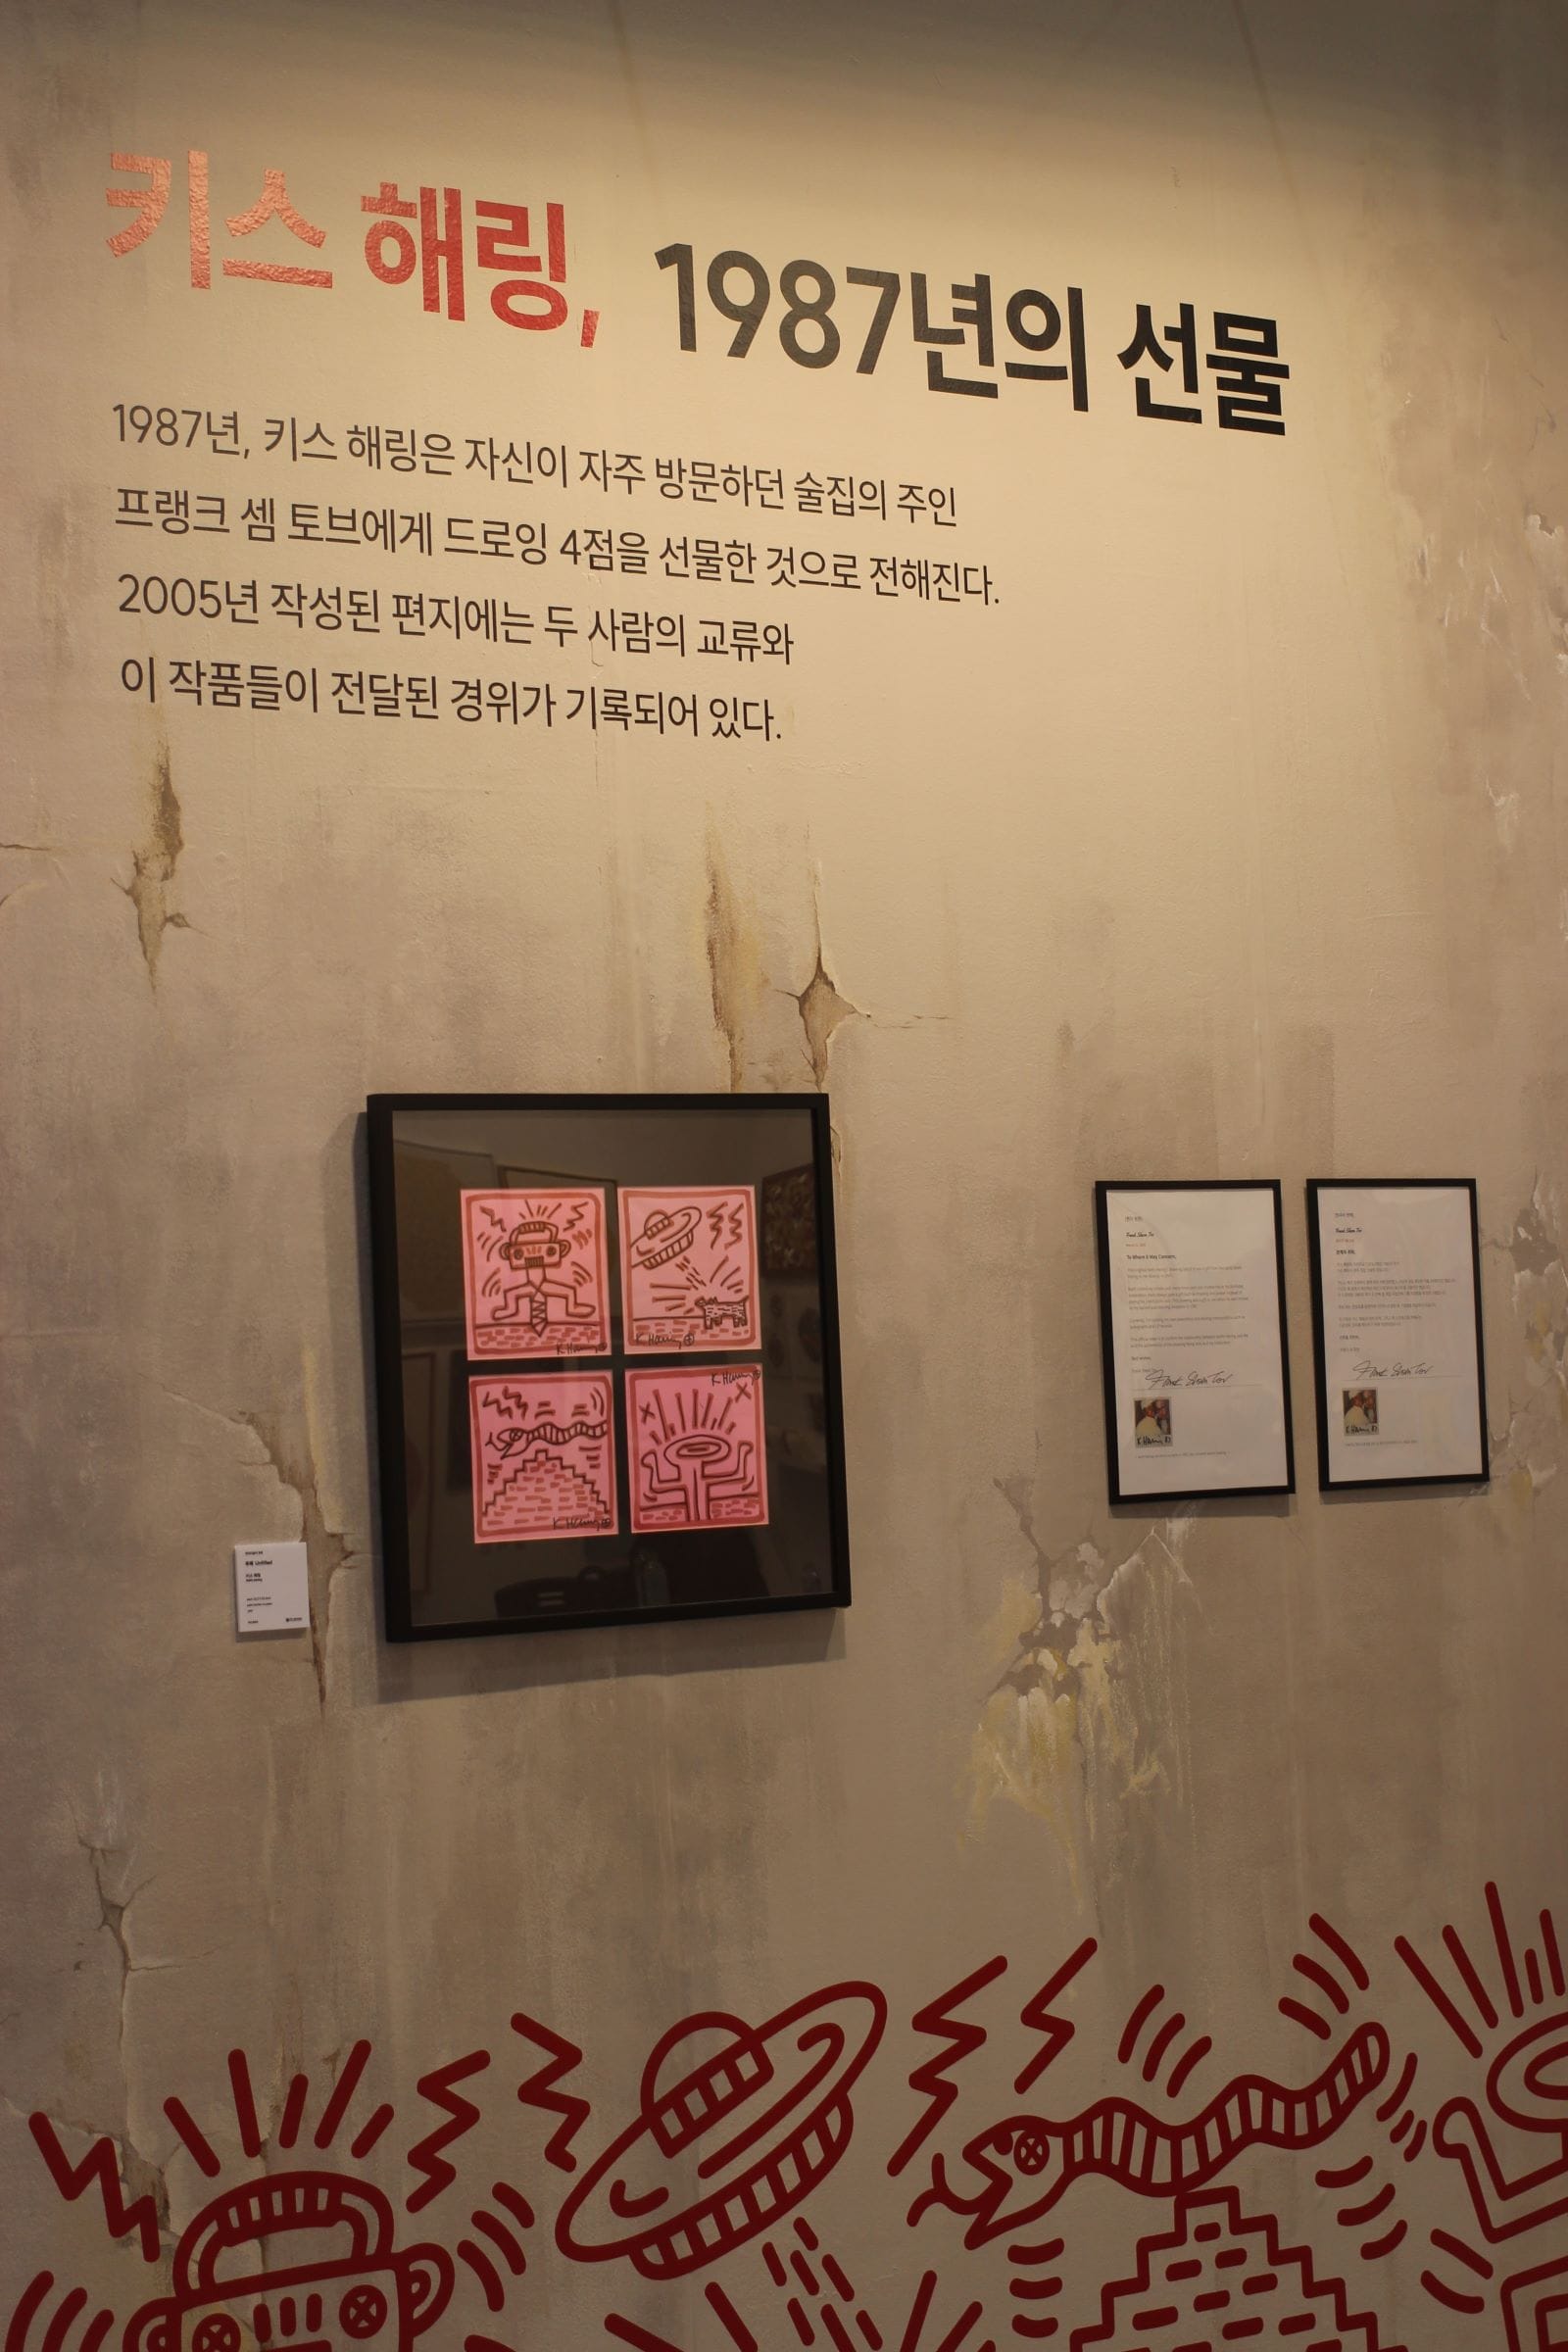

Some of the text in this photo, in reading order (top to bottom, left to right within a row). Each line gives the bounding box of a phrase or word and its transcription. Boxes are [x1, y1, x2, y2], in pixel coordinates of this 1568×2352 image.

[105, 150, 1290, 436] 키스 해링, 1987년의 선물
[113, 405, 956, 526] 1987년, 키스 해링은 자신이 자주 방문하던 술집의 주인
[116, 489, 999, 606] 프랭크 셈 토브에게 드로잉 4점을 선물한 것으로 전해진다.
[119, 574, 794, 664] 2005년 작성된 편지에는 두 사람의 교류와
[122, 657, 781, 741] 이 작품들이 전달된 경위가 기록되어 있다.
